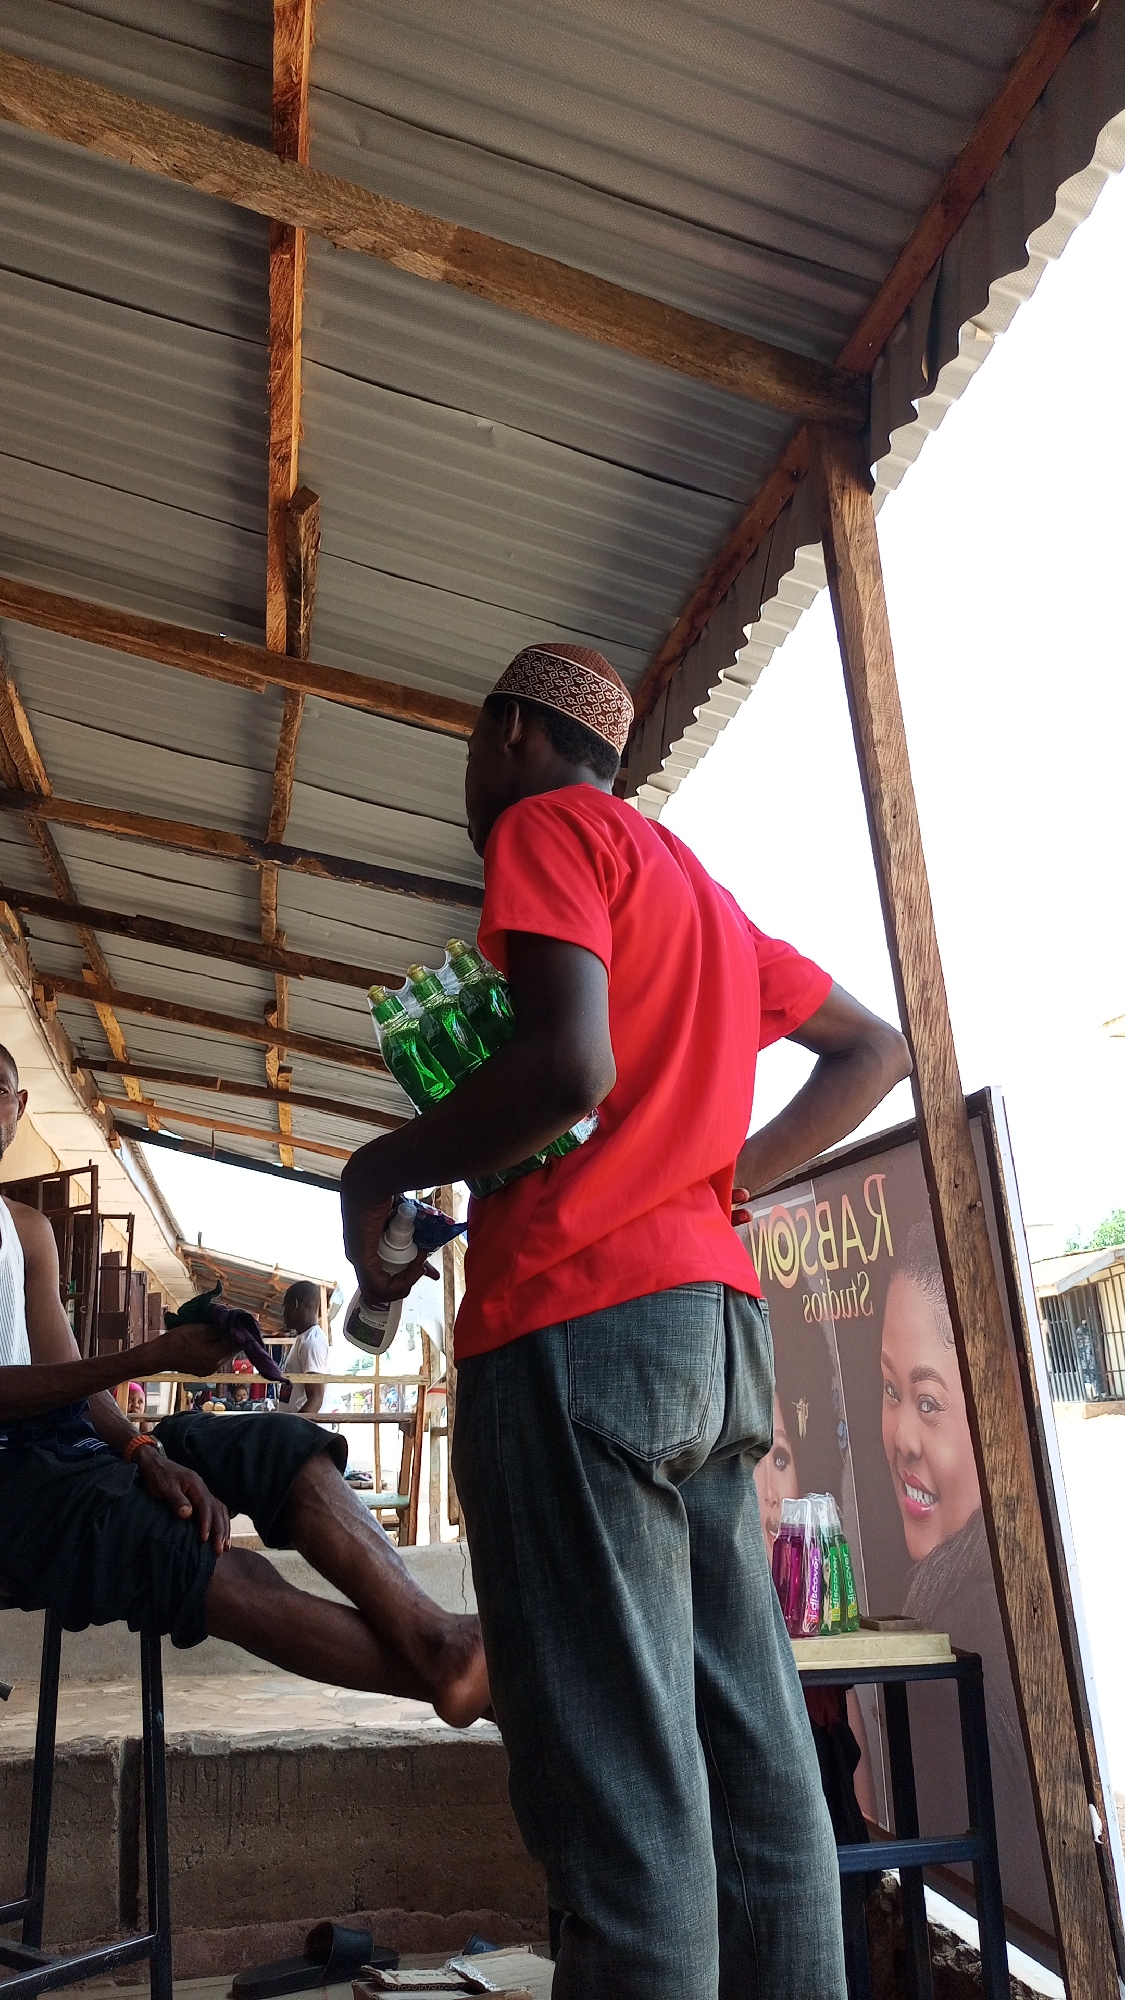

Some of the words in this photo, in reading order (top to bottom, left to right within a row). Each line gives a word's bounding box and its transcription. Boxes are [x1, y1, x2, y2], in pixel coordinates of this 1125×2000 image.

[810, 1555, 820, 1611] discover
[832, 1555, 840, 1609] discover
[843, 1551, 856, 1605] discover
